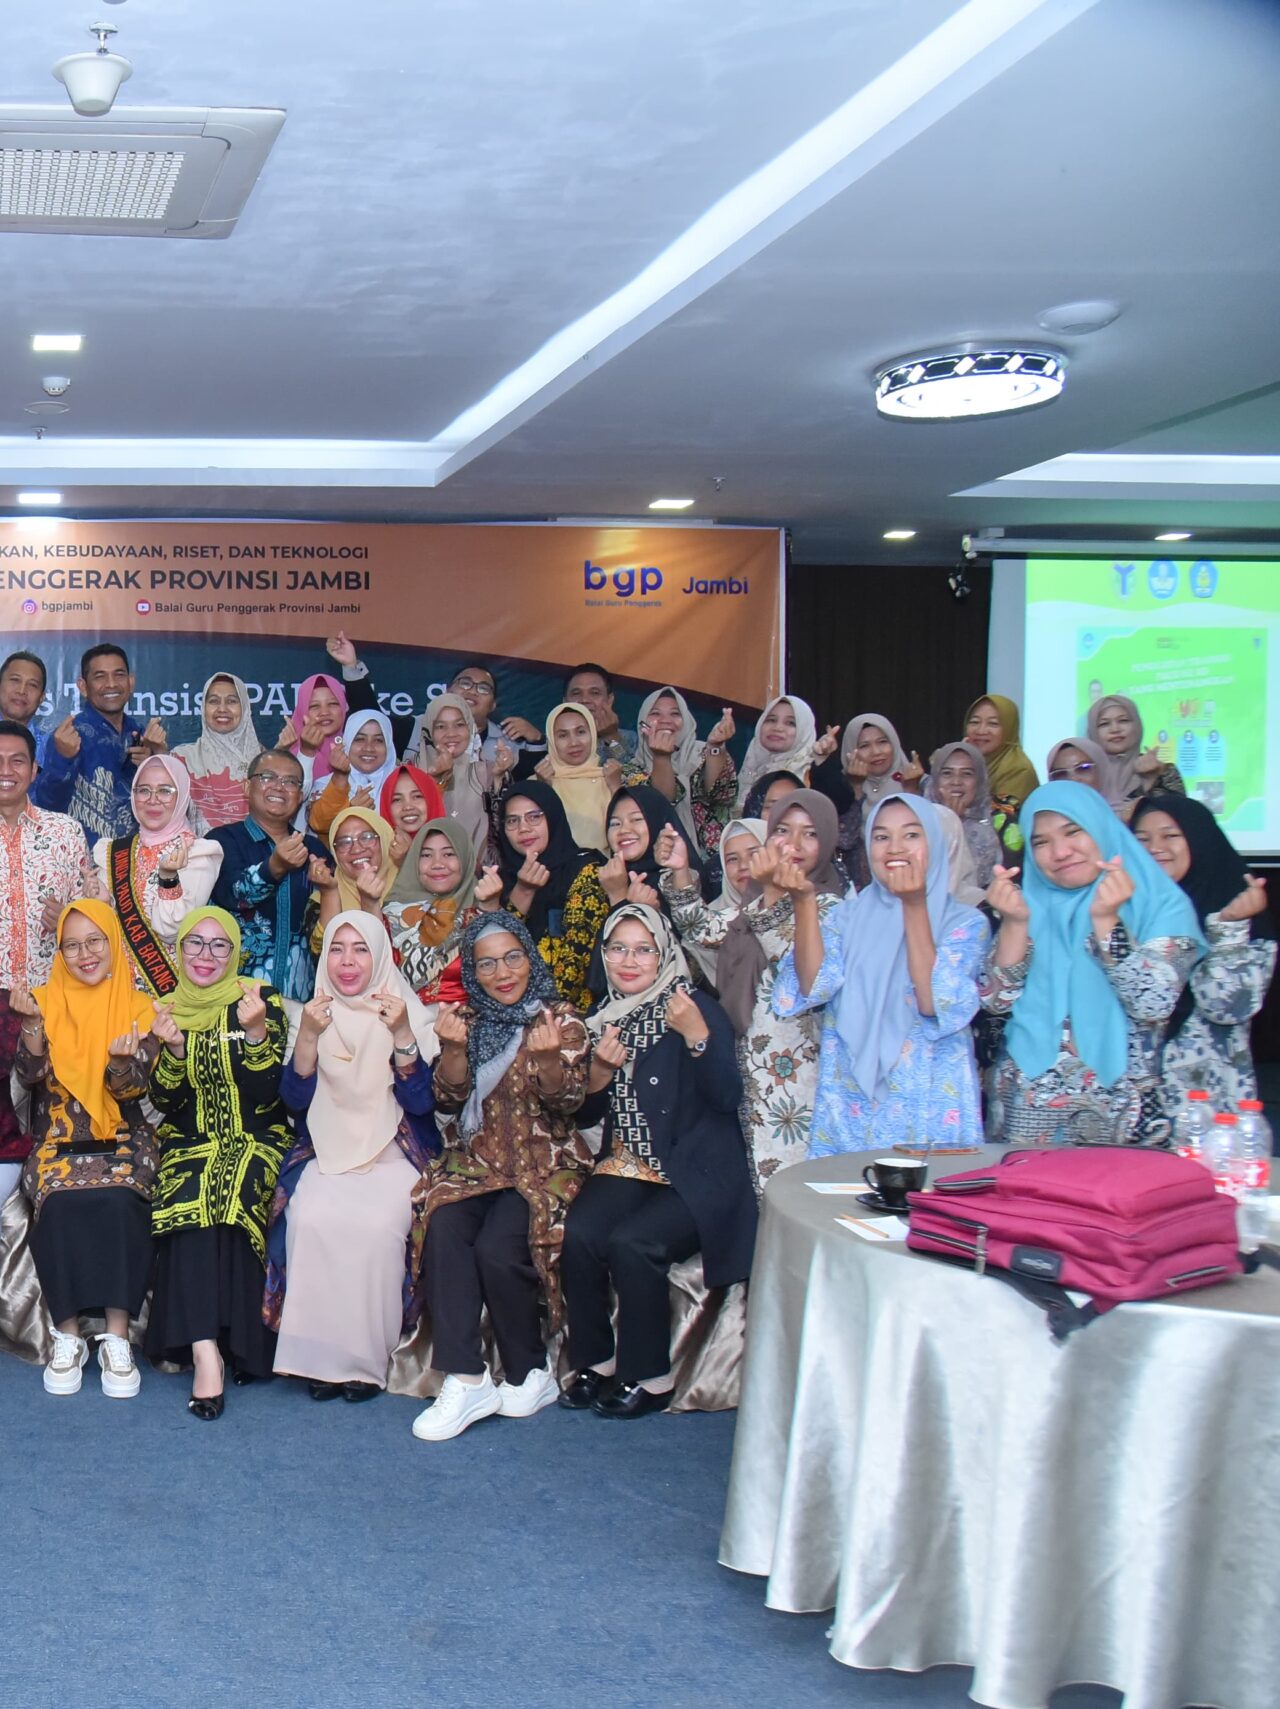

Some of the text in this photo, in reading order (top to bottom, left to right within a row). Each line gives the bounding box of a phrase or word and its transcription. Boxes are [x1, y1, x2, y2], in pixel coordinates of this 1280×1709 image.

[44, 544, 168, 560] KEBUDAYAAN,
[173, 545, 224, 560] RISET,
[229, 546, 265, 559] DAN
[270, 546, 369, 560] TEKNOLOGI
[150, 569, 278, 590] PROVINSI
[286, 570, 370, 590] JAMBI
[584, 560, 749, 597] bgp Jambi
[41, 600, 94, 613] bgpjambi
[155, 602, 361, 616] Balai Guru Penggerak Provinsi Jambi
[116, 882, 134, 914] PAUD
[124, 913, 147, 947] KAB.
[137, 943, 177, 994] BATANG
